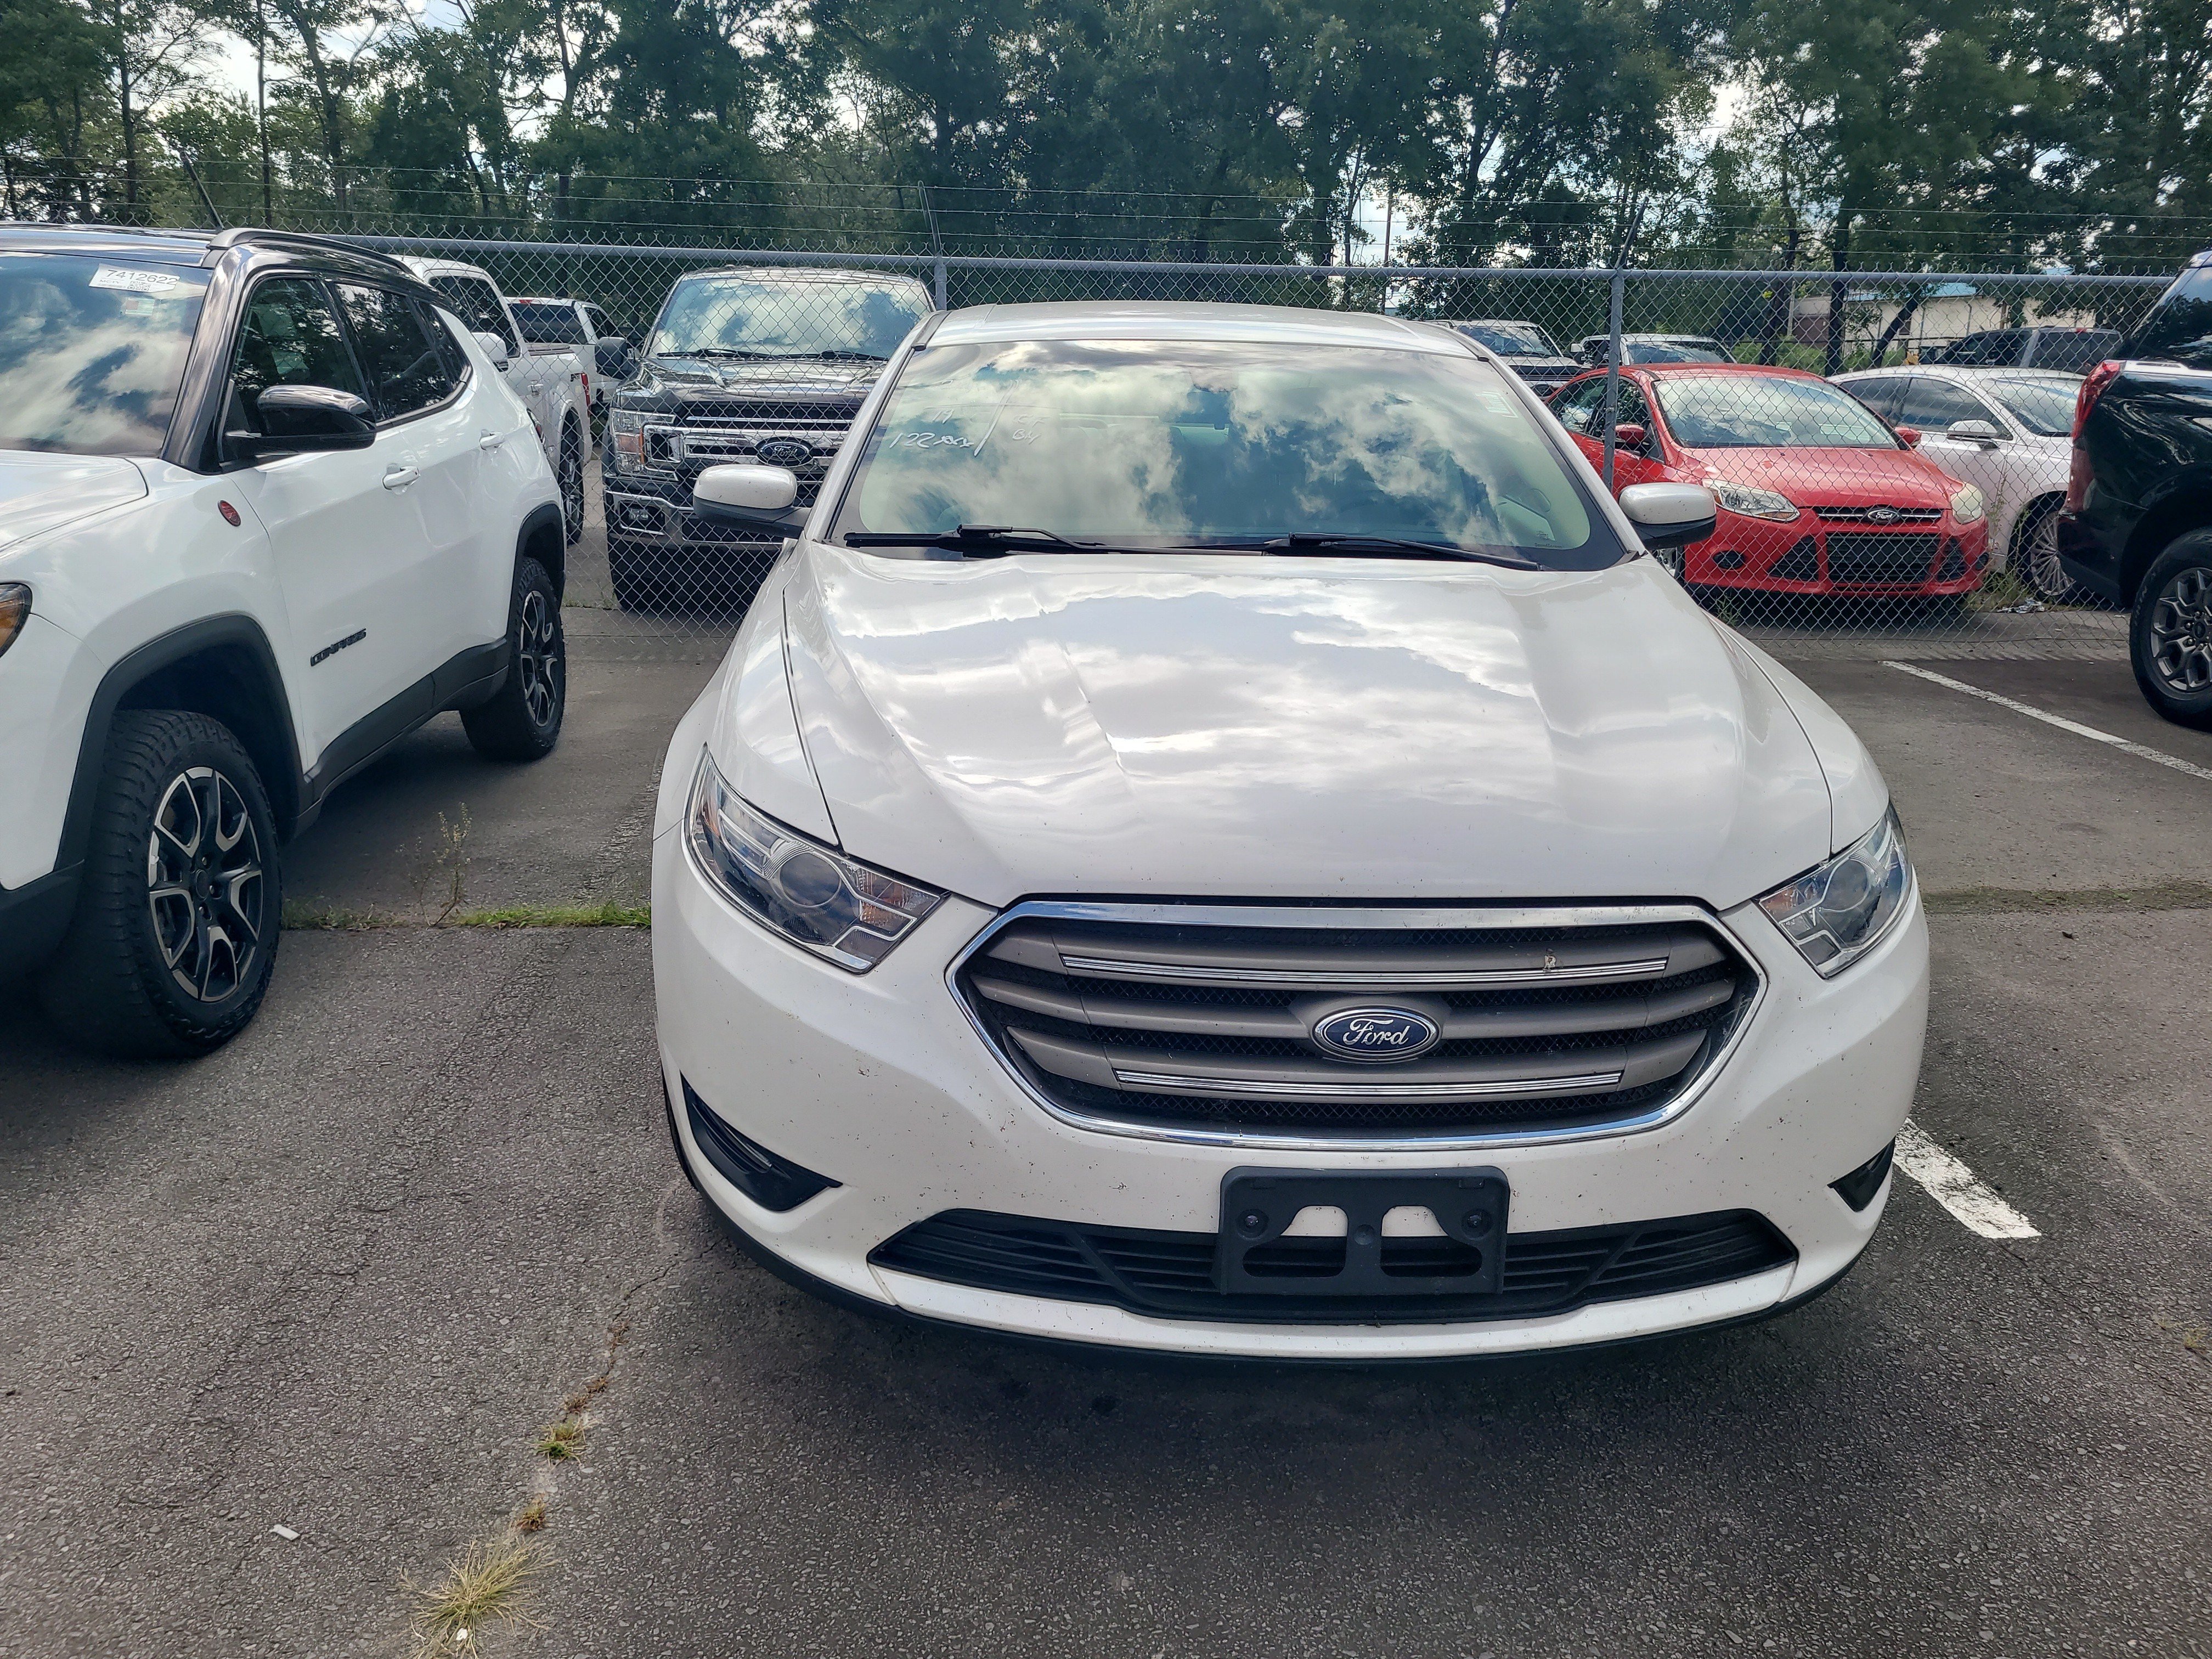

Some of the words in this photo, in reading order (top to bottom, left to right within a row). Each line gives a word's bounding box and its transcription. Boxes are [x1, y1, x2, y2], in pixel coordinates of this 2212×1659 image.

[106, 269, 178, 285] 7412622
[772, 445, 798, 457] Ford
[1342, 1018, 1410, 1046] Ford
